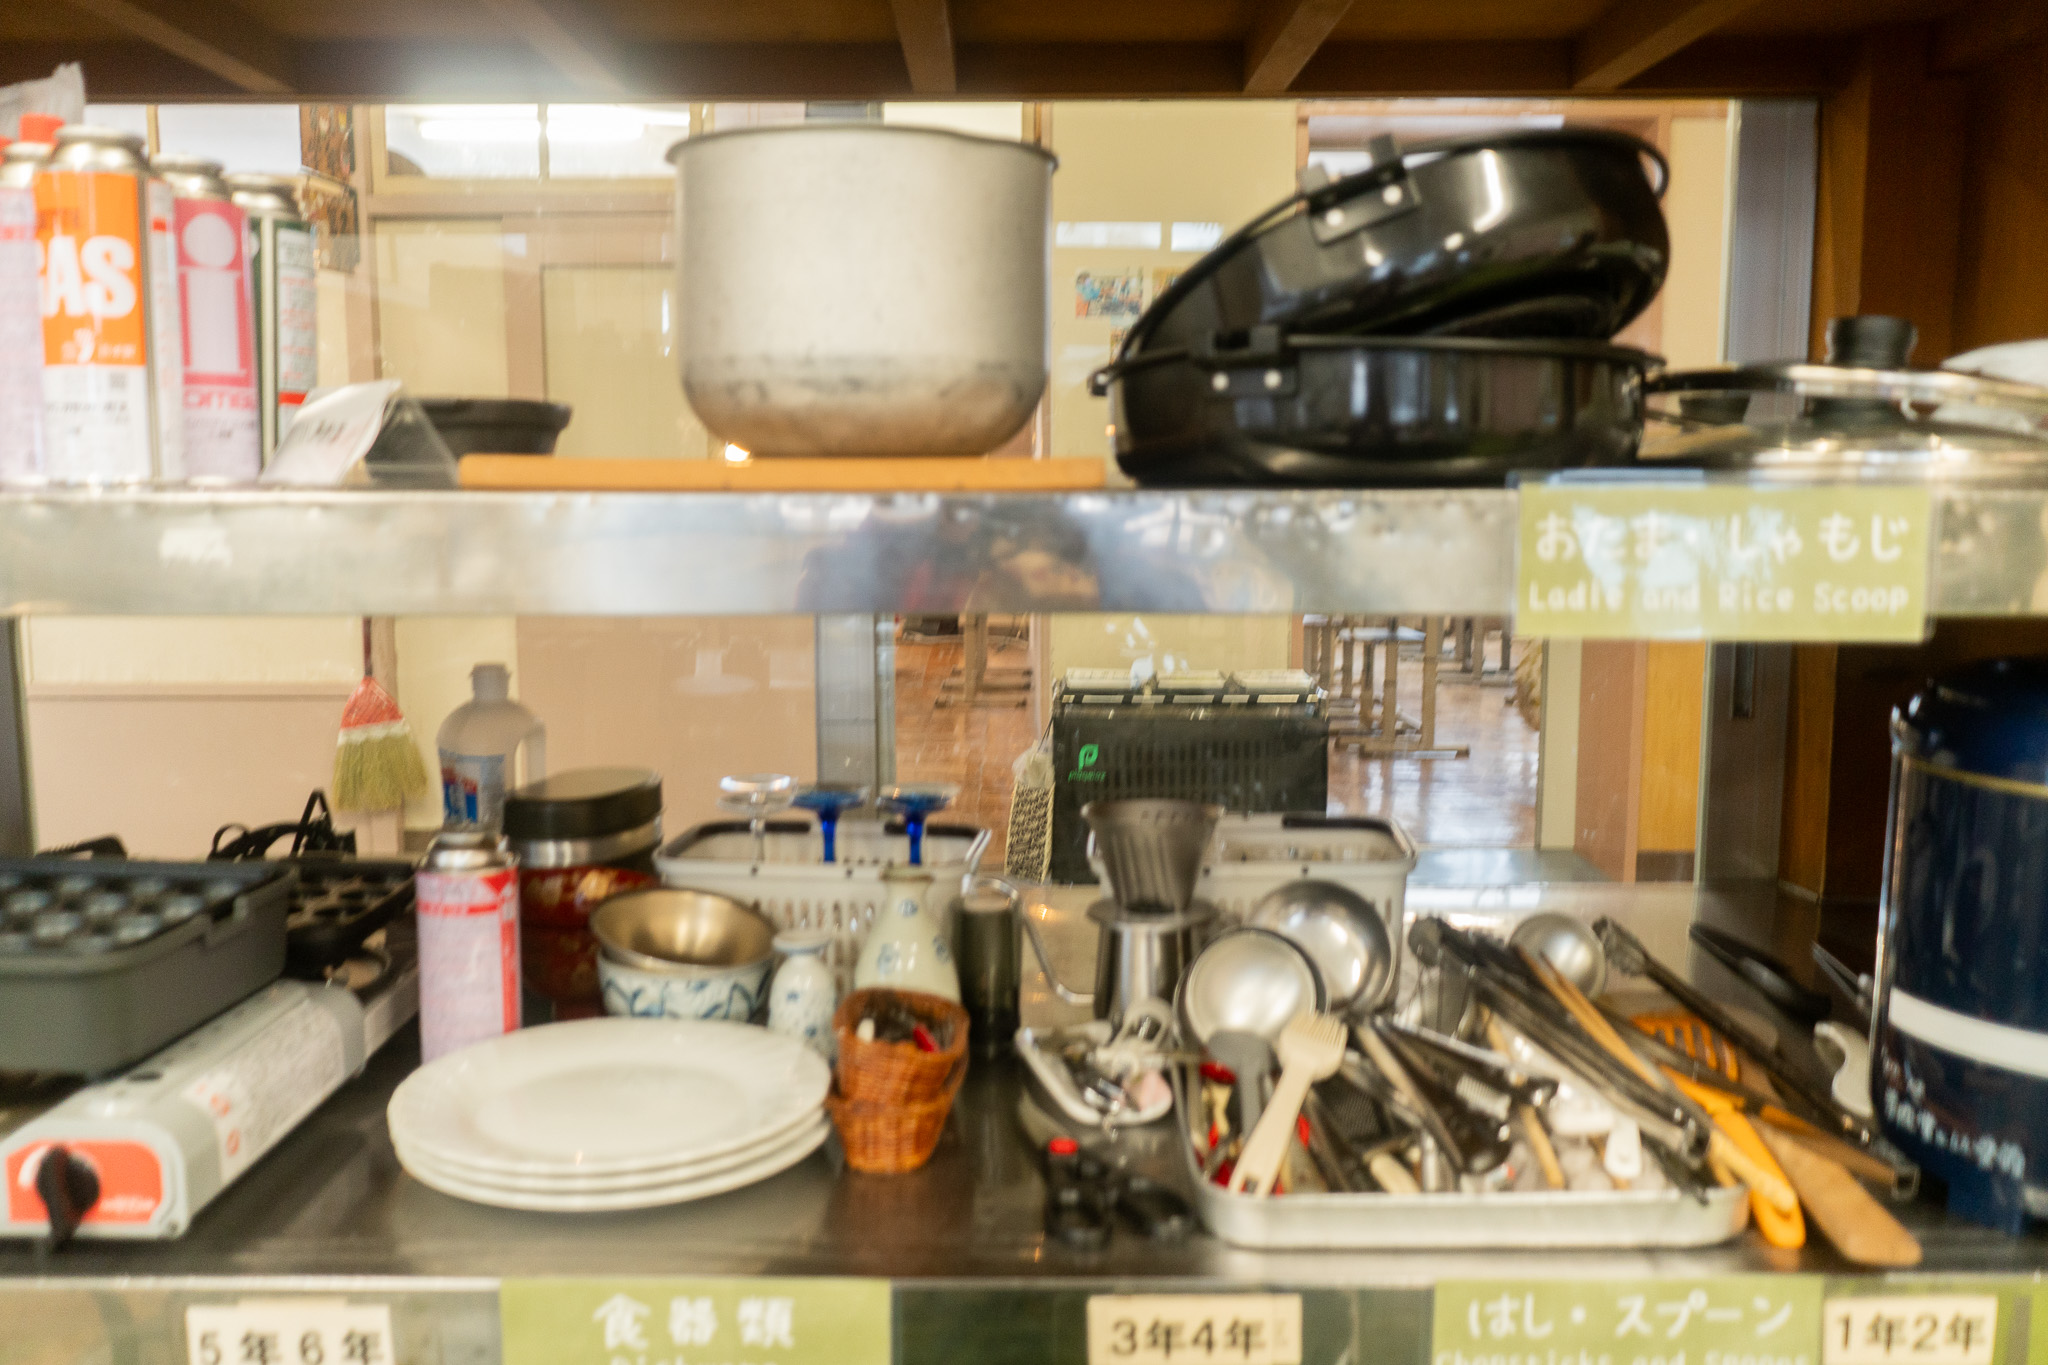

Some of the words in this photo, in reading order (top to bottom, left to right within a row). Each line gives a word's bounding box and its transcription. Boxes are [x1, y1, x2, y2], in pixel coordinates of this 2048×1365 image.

[37, 234, 137, 318] AS
[1536, 511, 1909, 563] おたま・しゃもじ
[1641, 581, 1700, 612] and
[1718, 579, 1794, 613] Rice
[1813, 580, 1909, 617] Scoop
[1111, 1314, 1266, 1359] 3年4年
[1467, 1287, 1793, 1340] はし・スプーン
[1838, 1310, 1988, 1357] 1年2年
[199, 1327, 385, 1365] 5年6年
